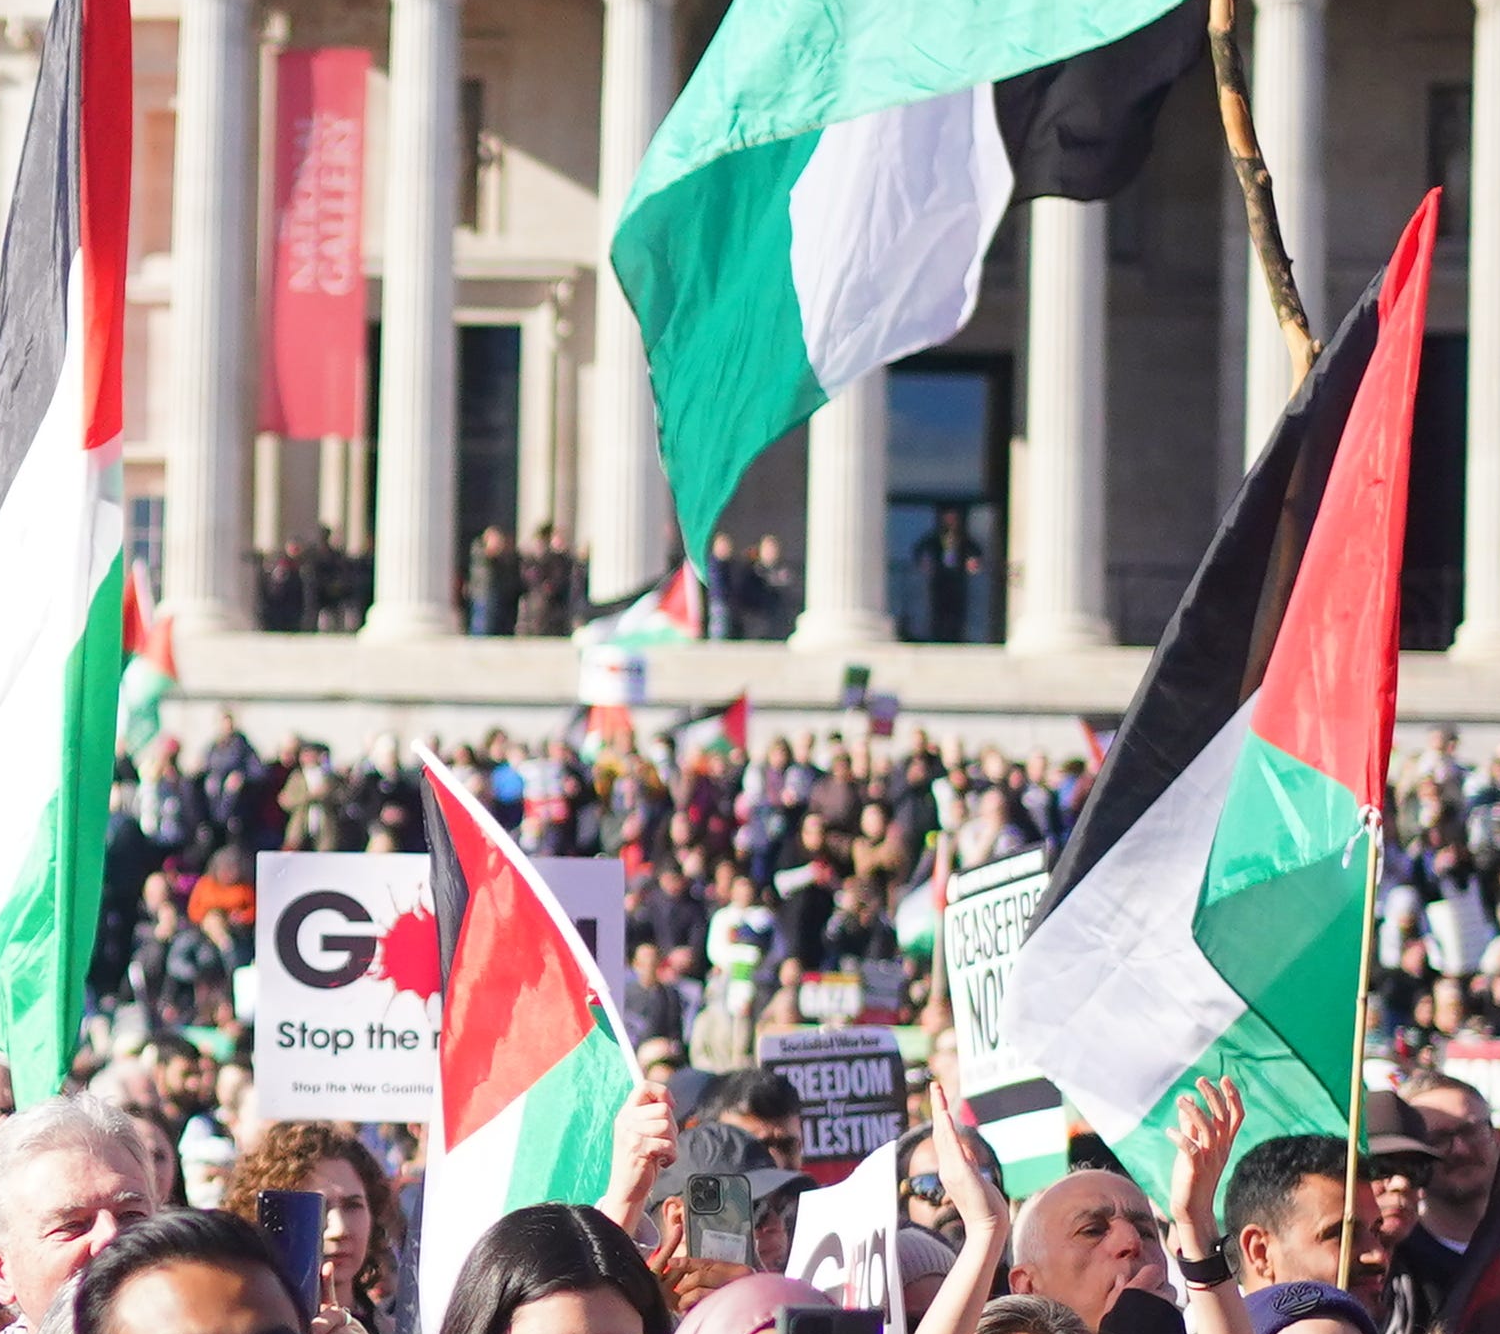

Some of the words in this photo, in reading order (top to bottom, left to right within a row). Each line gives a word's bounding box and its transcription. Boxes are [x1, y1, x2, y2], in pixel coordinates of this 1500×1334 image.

[317, 113, 360, 296] GALLERY
[277, 1021, 353, 1055] Stop
[366, 1023, 419, 1050] the
[291, 1081, 321, 1095] Stop
[351, 1082, 377, 1094] War
[381, 1081, 434, 1094] Coalitio
[825, 1099, 846, 1119] for
[801, 1113, 902, 1157] LESTINE
